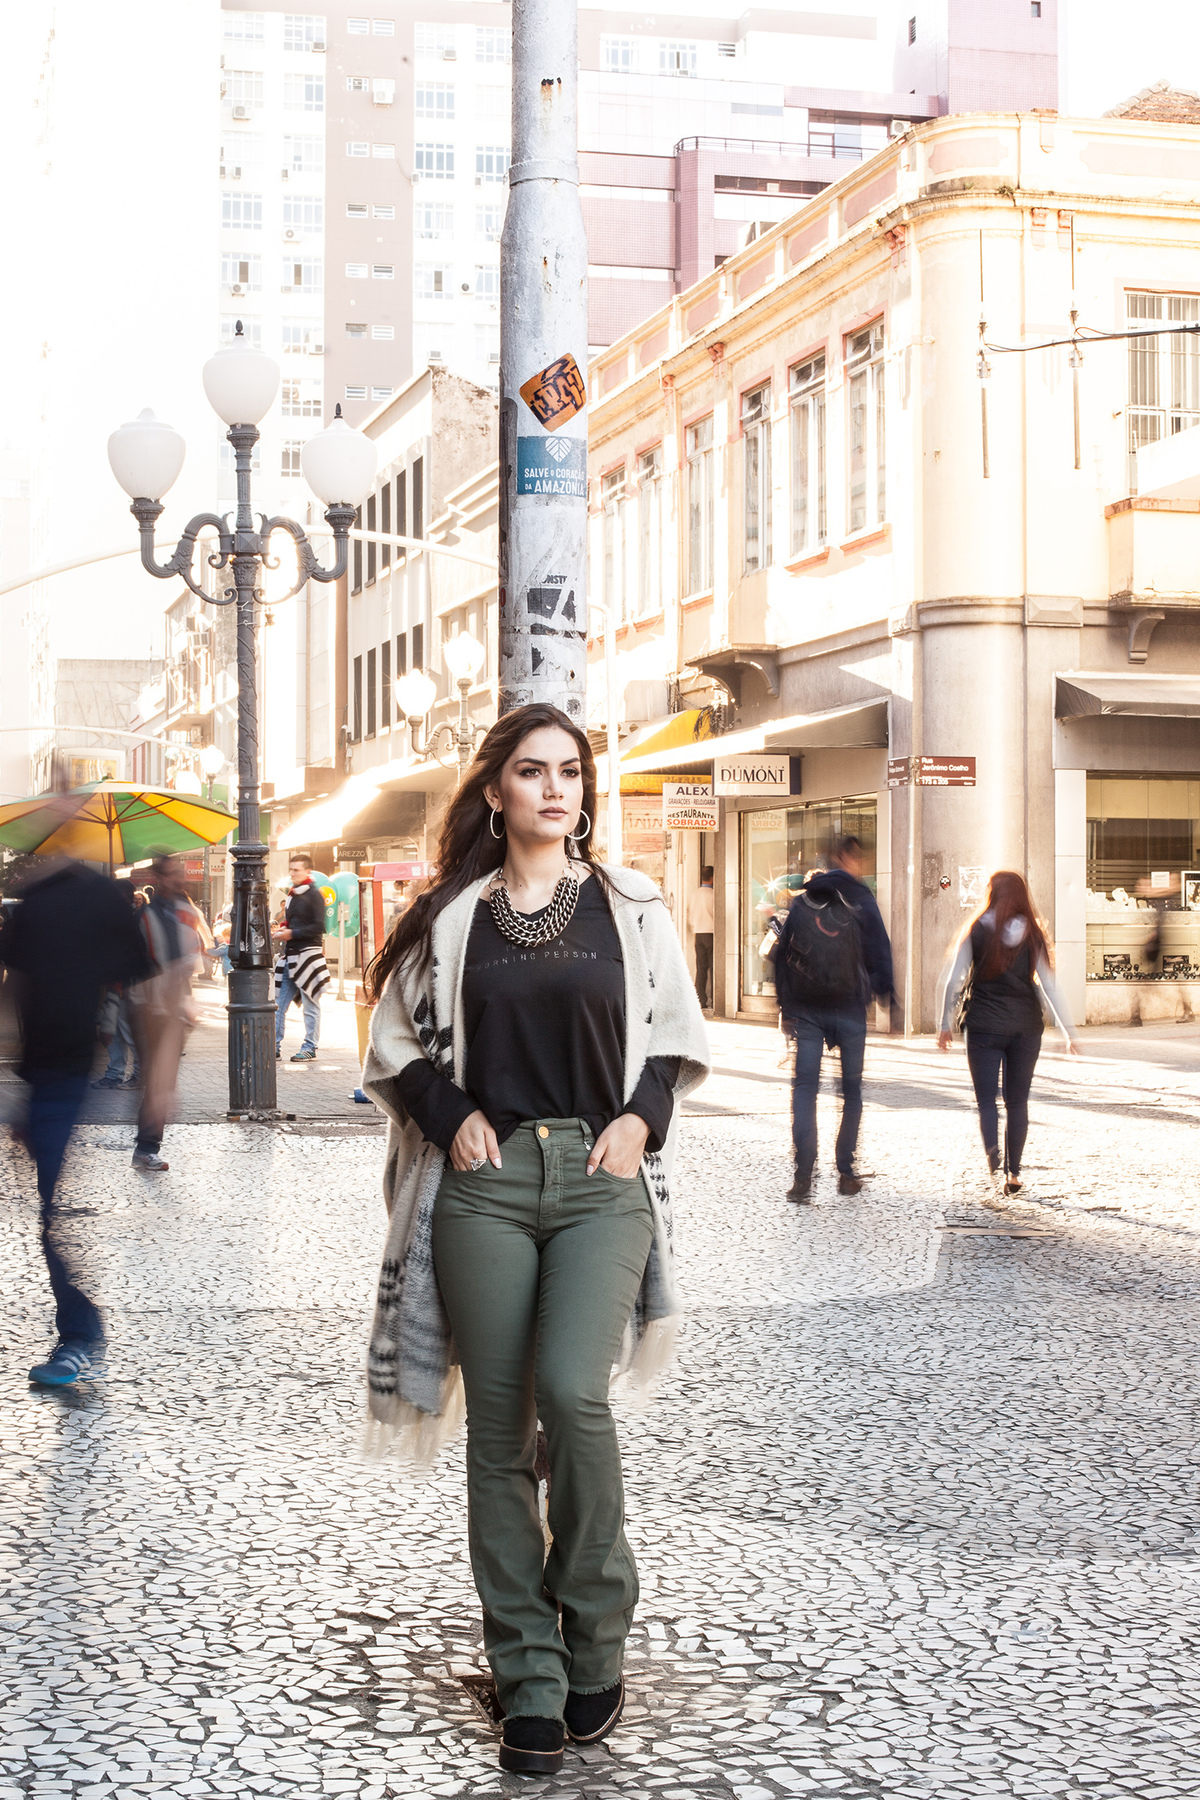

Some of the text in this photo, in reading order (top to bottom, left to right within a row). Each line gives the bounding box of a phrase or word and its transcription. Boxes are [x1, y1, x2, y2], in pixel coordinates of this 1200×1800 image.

[524, 467, 550, 478] SALVE
[556, 467, 584, 482] CORAÇÃO
[534, 478, 584, 496] AMAZÔNIA
[721, 769, 784, 783] DUMONT
[676, 787, 708, 796] ALEX
[668, 797, 690, 805] GRAVAÇÕES
[668, 809, 714, 818] RESTAURANTE
[325, 894, 333, 904] oi
[544, 951, 597, 960] PERSON
